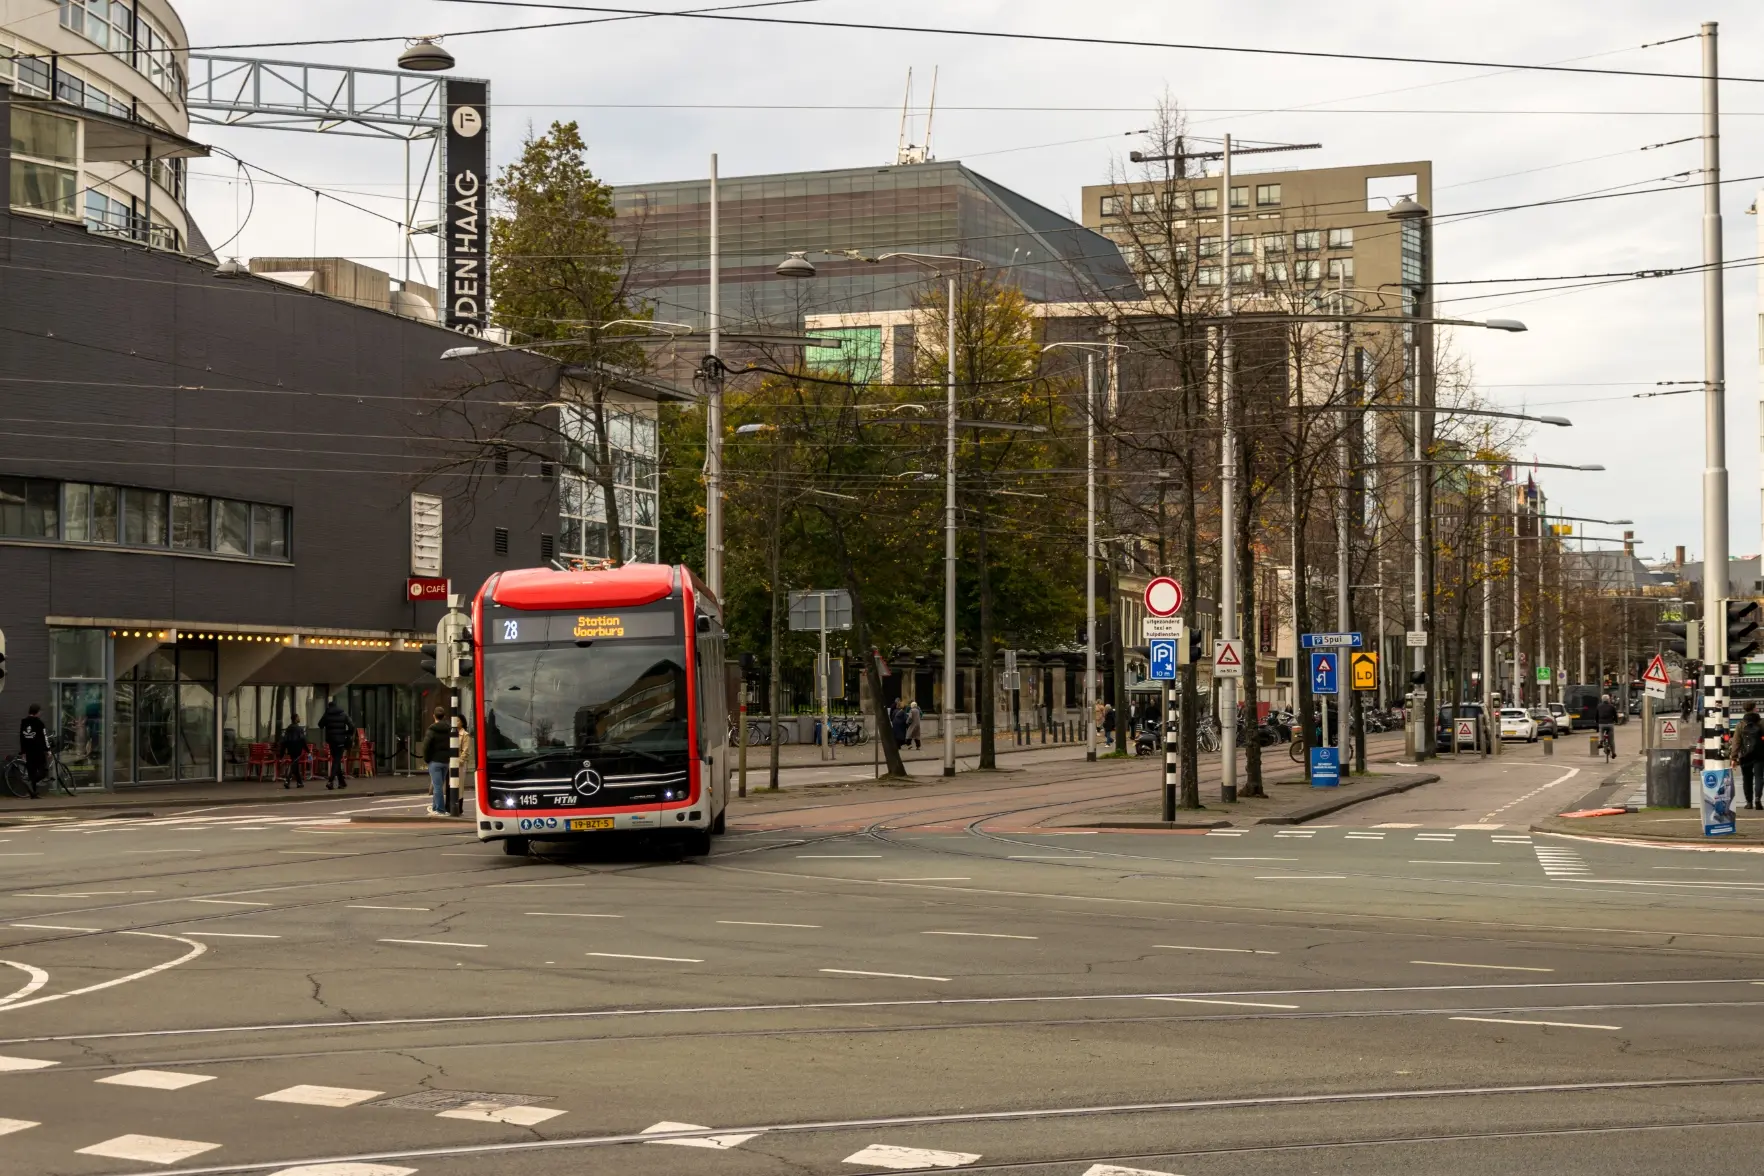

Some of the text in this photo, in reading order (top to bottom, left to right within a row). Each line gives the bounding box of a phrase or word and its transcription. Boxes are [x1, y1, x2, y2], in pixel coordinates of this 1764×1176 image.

[454, 169, 479, 254] HAAG
[454, 258, 478, 317] DEN
[425, 583, 446, 593] CAFÉ
[578, 616, 620, 627] Station
[503, 620, 518, 640] 28
[573, 626, 625, 637] Voorburg
[1324, 635, 1342, 644] Spui
[1157, 649, 1169, 663] P
[519, 794, 538, 806] 1415
[553, 795, 578, 804] HTM
[574, 820, 610, 829] 19-BZT-5
